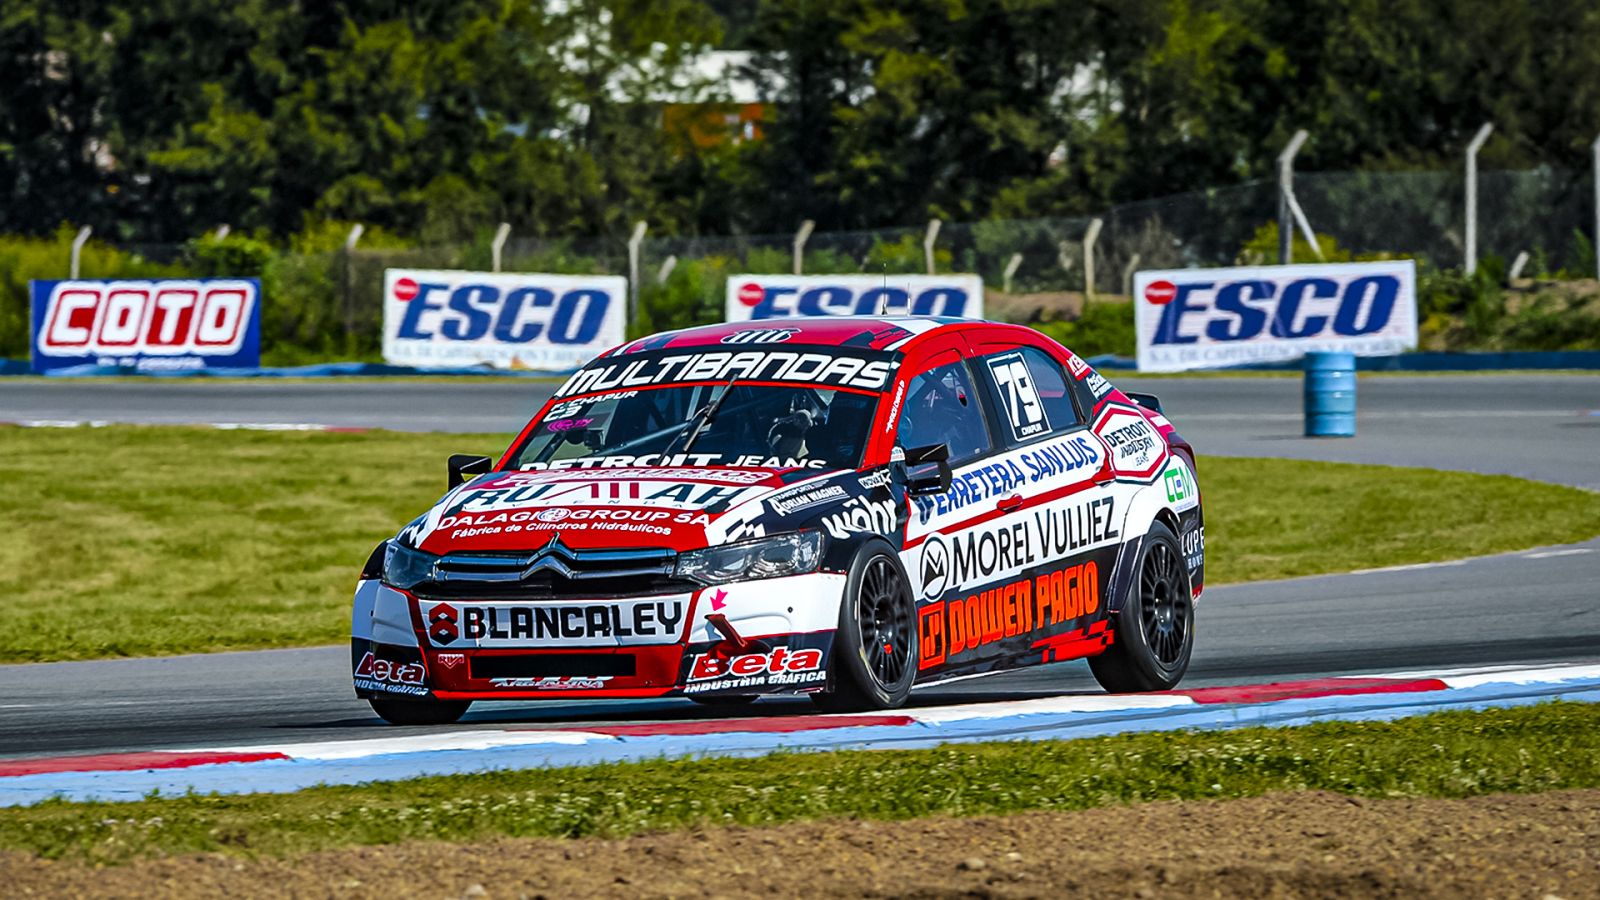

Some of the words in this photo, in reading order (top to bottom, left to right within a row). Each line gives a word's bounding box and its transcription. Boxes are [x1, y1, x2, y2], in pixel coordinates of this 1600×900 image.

[45, 289, 248, 346] COTO
[397, 283, 610, 344] ESCO
[1152, 275, 1400, 345] ESCO
[553, 350, 900, 398] MULTIBANDAS
[993, 361, 1043, 428] 79
[568, 390, 638, 407] CHAPUR
[1104, 420, 1150, 448] DETROIT
[924, 457, 1026, 516] ERRETERA
[451, 526, 501, 539] Fábrica
[505, 524, 521, 532] de
[525, 522, 588, 532] Cilindros
[591, 522, 672, 536] Hidráulicos
[952, 520, 1035, 585] MOREL
[1034, 495, 1119, 559] VULLIEZ
[463, 602, 682, 640] BLANCALEY
[684, 674, 765, 693] INDUSTRIA
[687, 646, 824, 682] Beta
